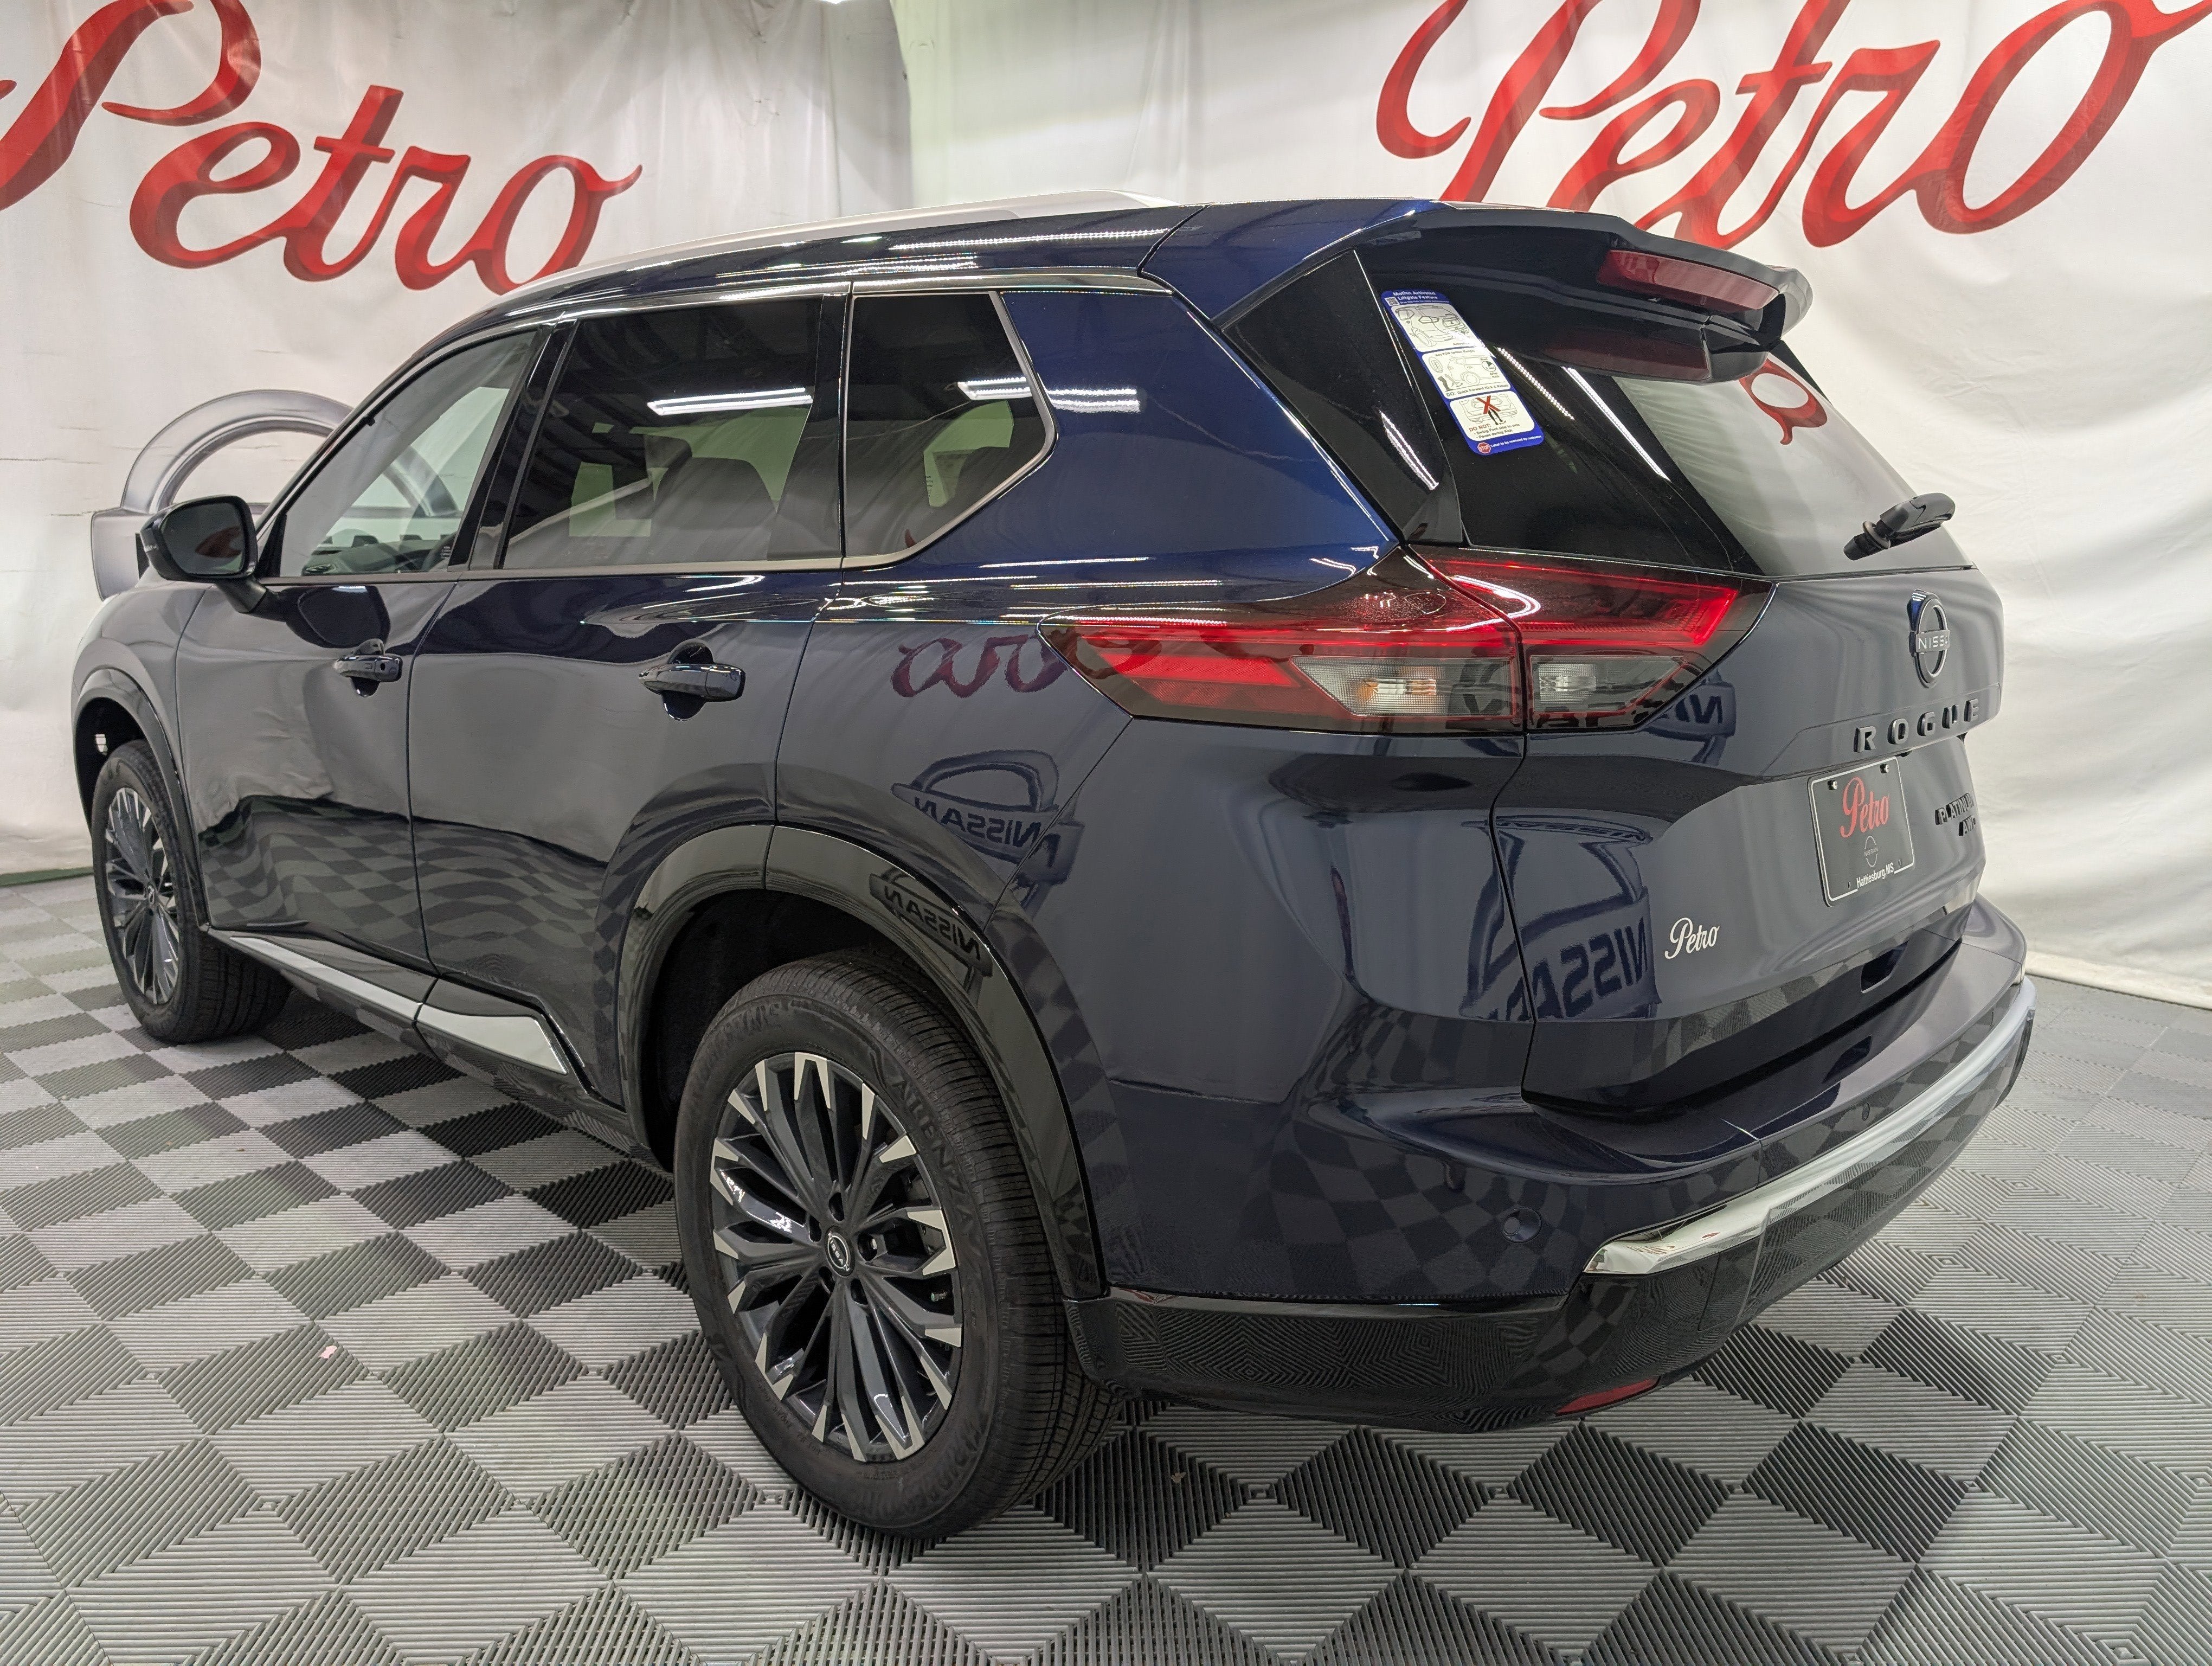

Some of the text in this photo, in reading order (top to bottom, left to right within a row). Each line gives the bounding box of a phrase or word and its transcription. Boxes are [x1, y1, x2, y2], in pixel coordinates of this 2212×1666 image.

[1376, 0, 2212, 247] Petro
[0, 0, 642, 296] Petro
[1918, 635, 1949, 650] NISSA
[1853, 698, 1979, 753] ROGUE
[1840, 777, 1890, 838] Petro
[1864, 847, 1879, 857] NISSAN
[1664, 917, 1721, 959] Petro
[827, 1231, 850, 1272] NISSAN
